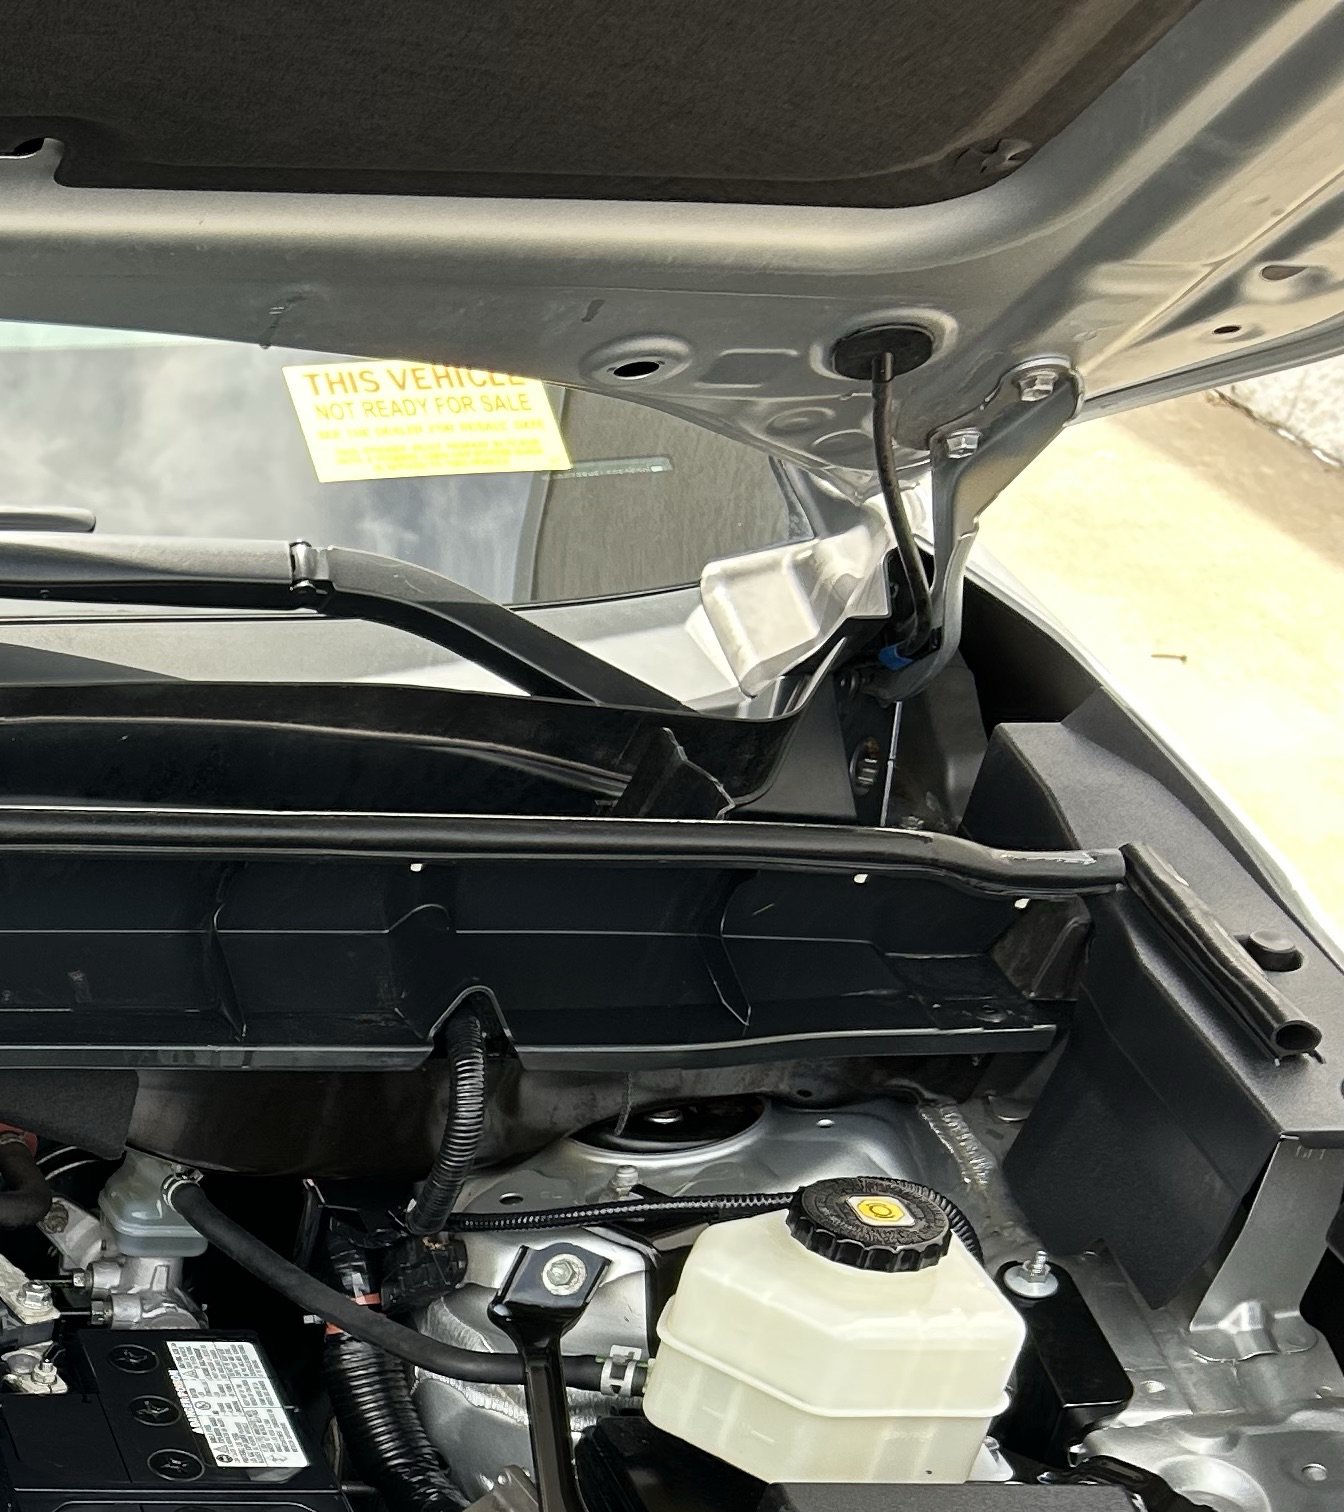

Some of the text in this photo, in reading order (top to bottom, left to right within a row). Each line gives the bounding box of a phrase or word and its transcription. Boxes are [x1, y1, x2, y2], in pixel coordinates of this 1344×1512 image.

[303, 367, 526, 396] THIS VEHICLE
[314, 393, 532, 422] NOT READY FOR SALE
